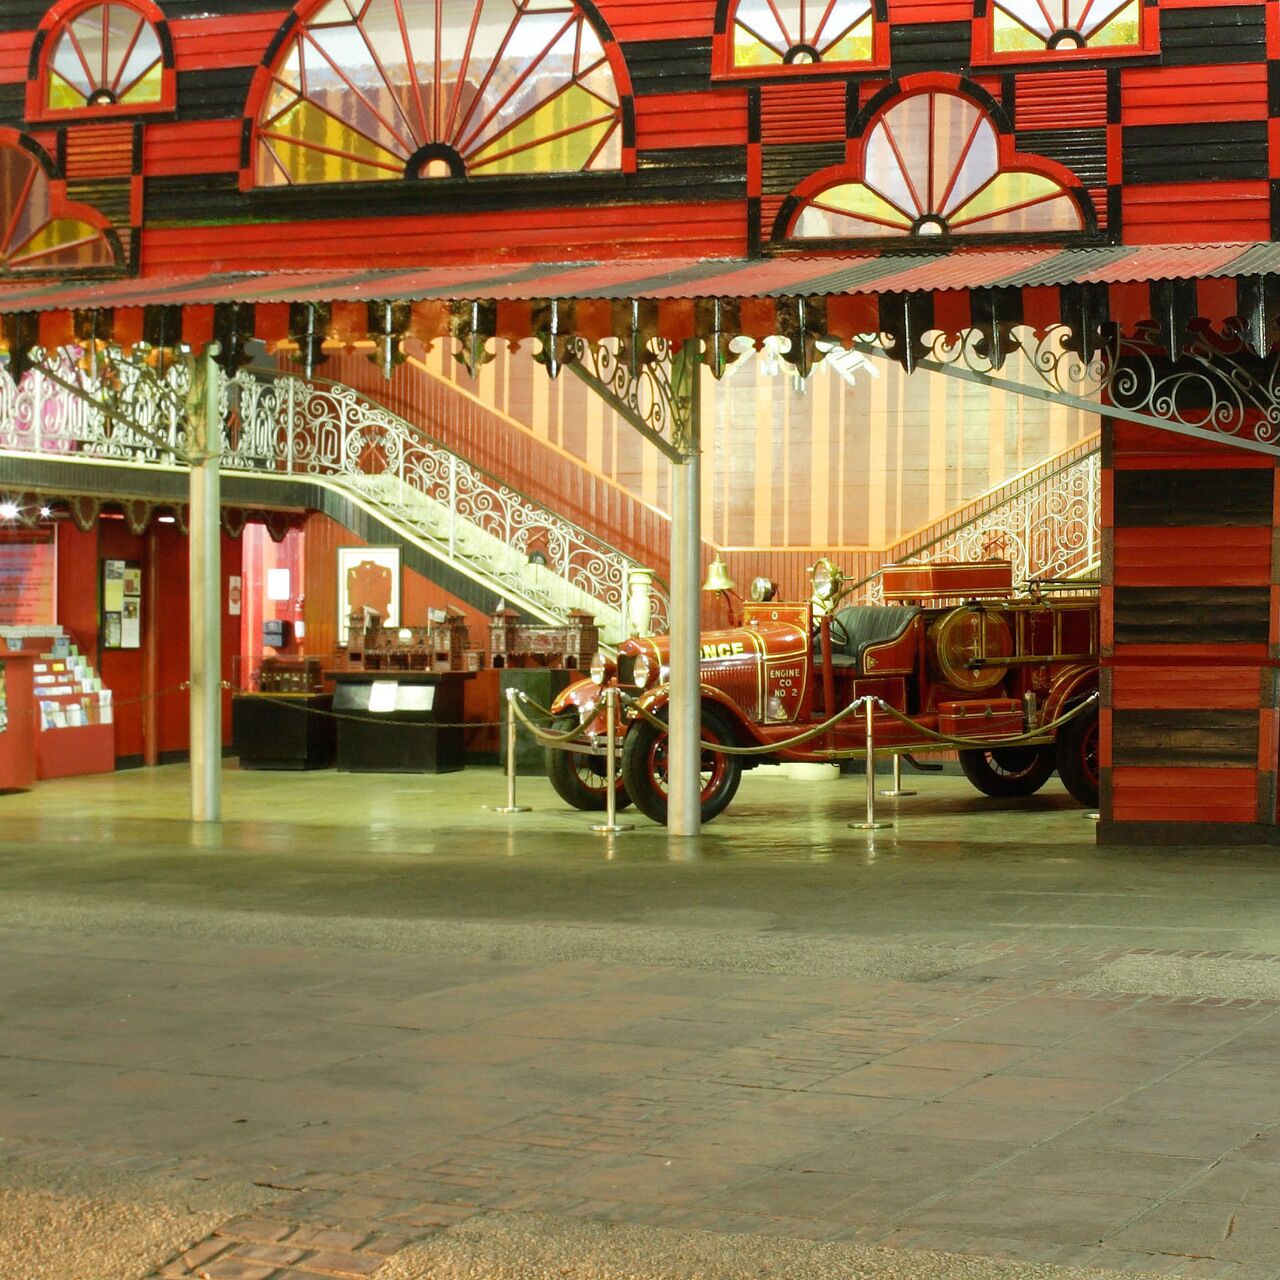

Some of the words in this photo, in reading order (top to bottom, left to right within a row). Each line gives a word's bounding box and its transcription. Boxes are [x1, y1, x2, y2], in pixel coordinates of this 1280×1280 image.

[700, 642, 744, 660] NCE
[770, 668, 801, 679] ENGINE
[774, 689, 786, 697] NO
[791, 688, 798, 697] 2
